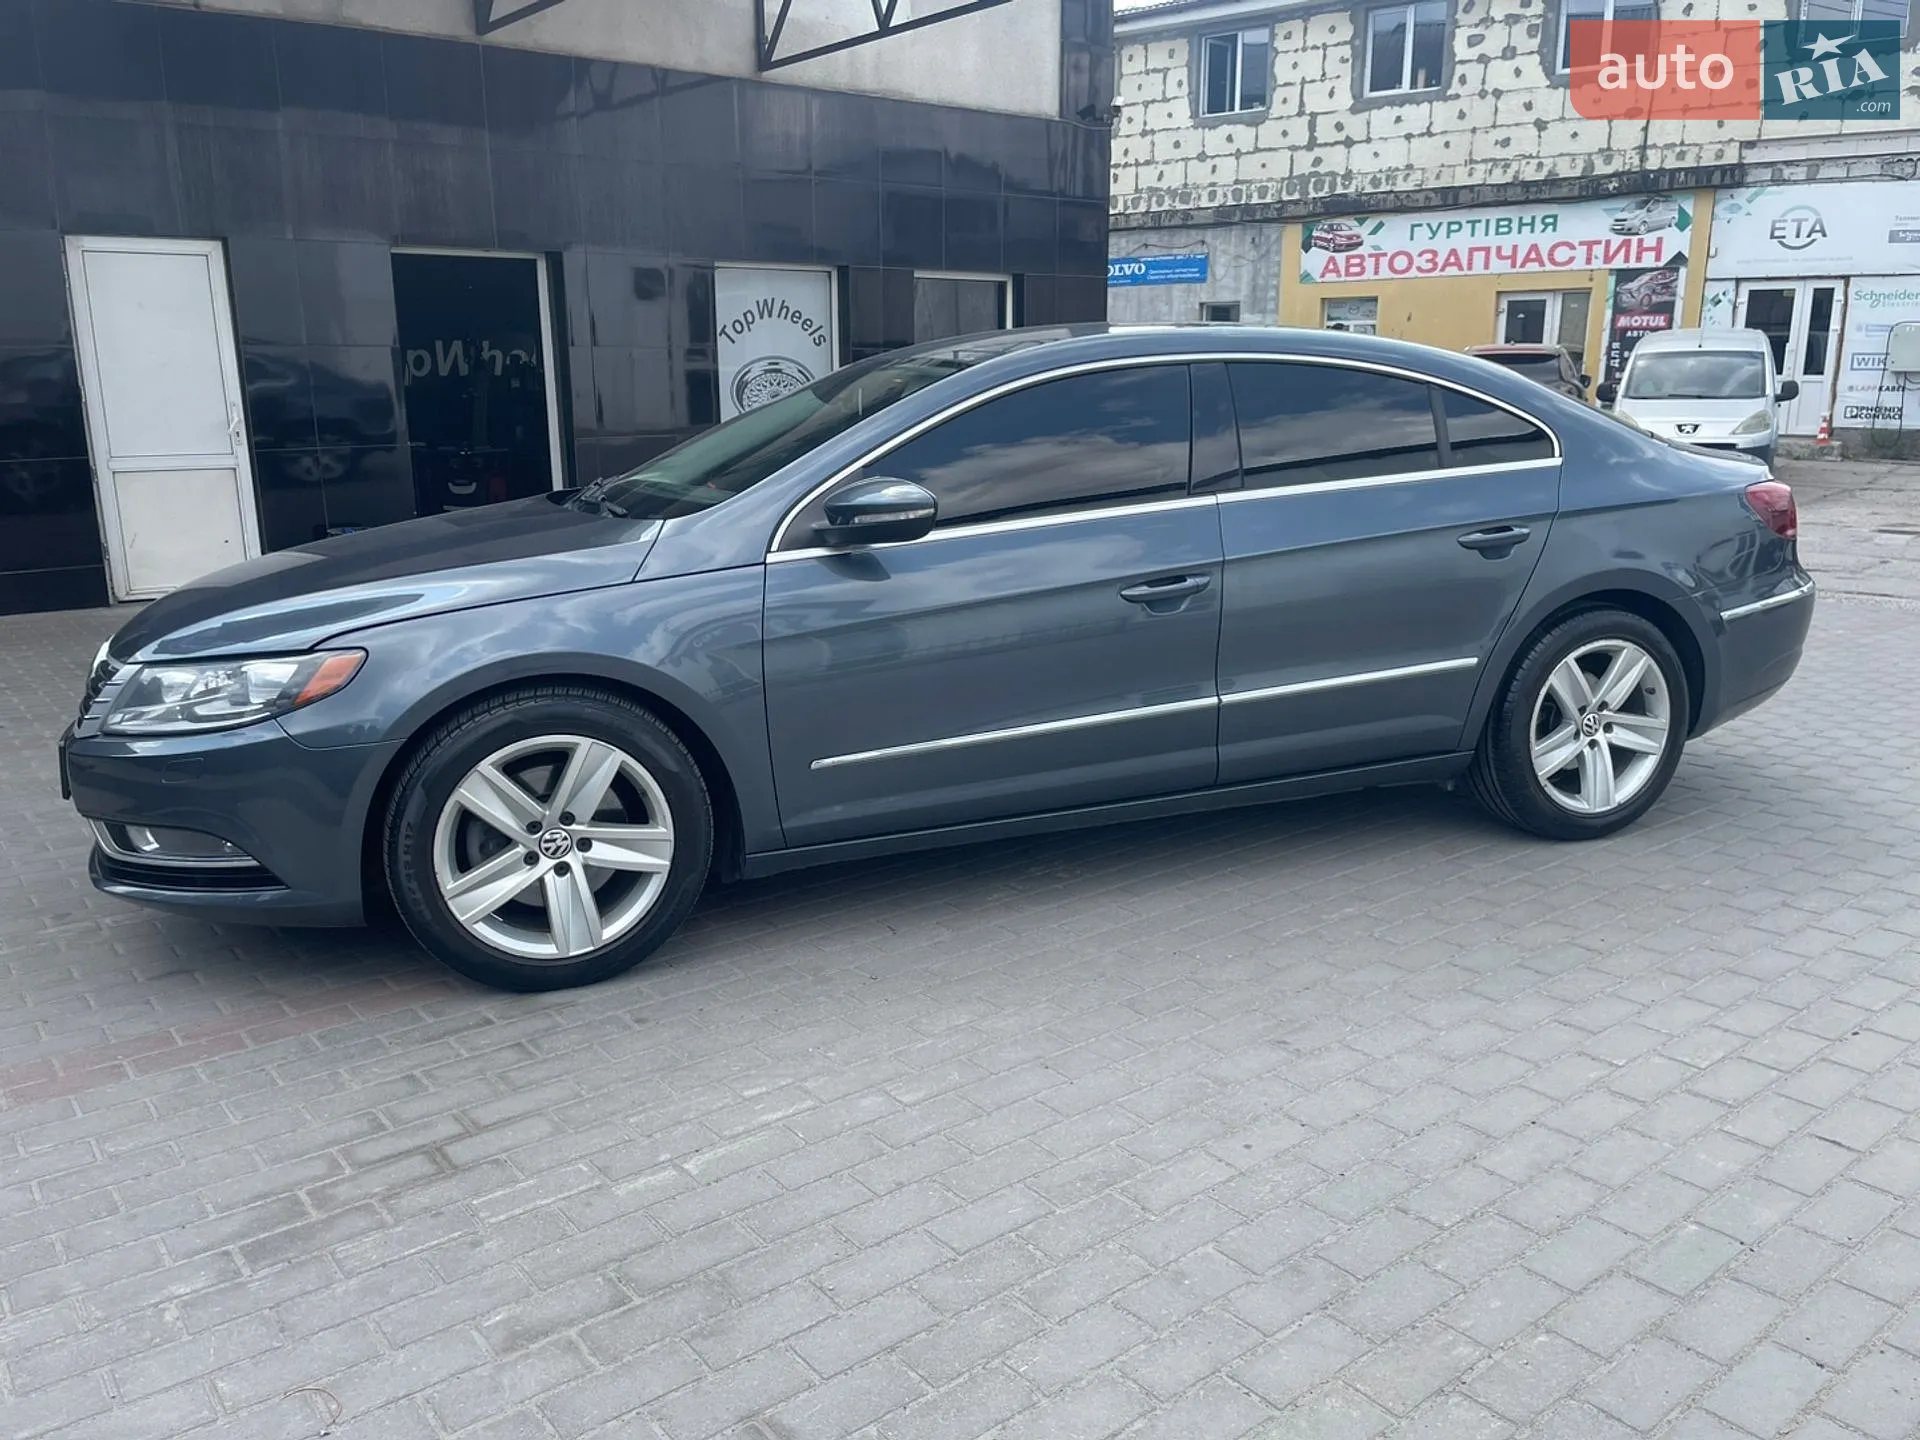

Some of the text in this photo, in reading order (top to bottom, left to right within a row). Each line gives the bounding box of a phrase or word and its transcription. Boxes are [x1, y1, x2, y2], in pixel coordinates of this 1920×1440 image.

[1409, 213, 1559, 241] ГУРТІВНЯ
[1769, 217, 1828, 240] ETA
[1107, 262, 1146, 277] OLVO
[1319, 236, 1665, 279] АВТОЗАПЧАСТИН
[719, 297, 827, 347] TopWheels
[1617, 315, 1666, 328] MOTUL
